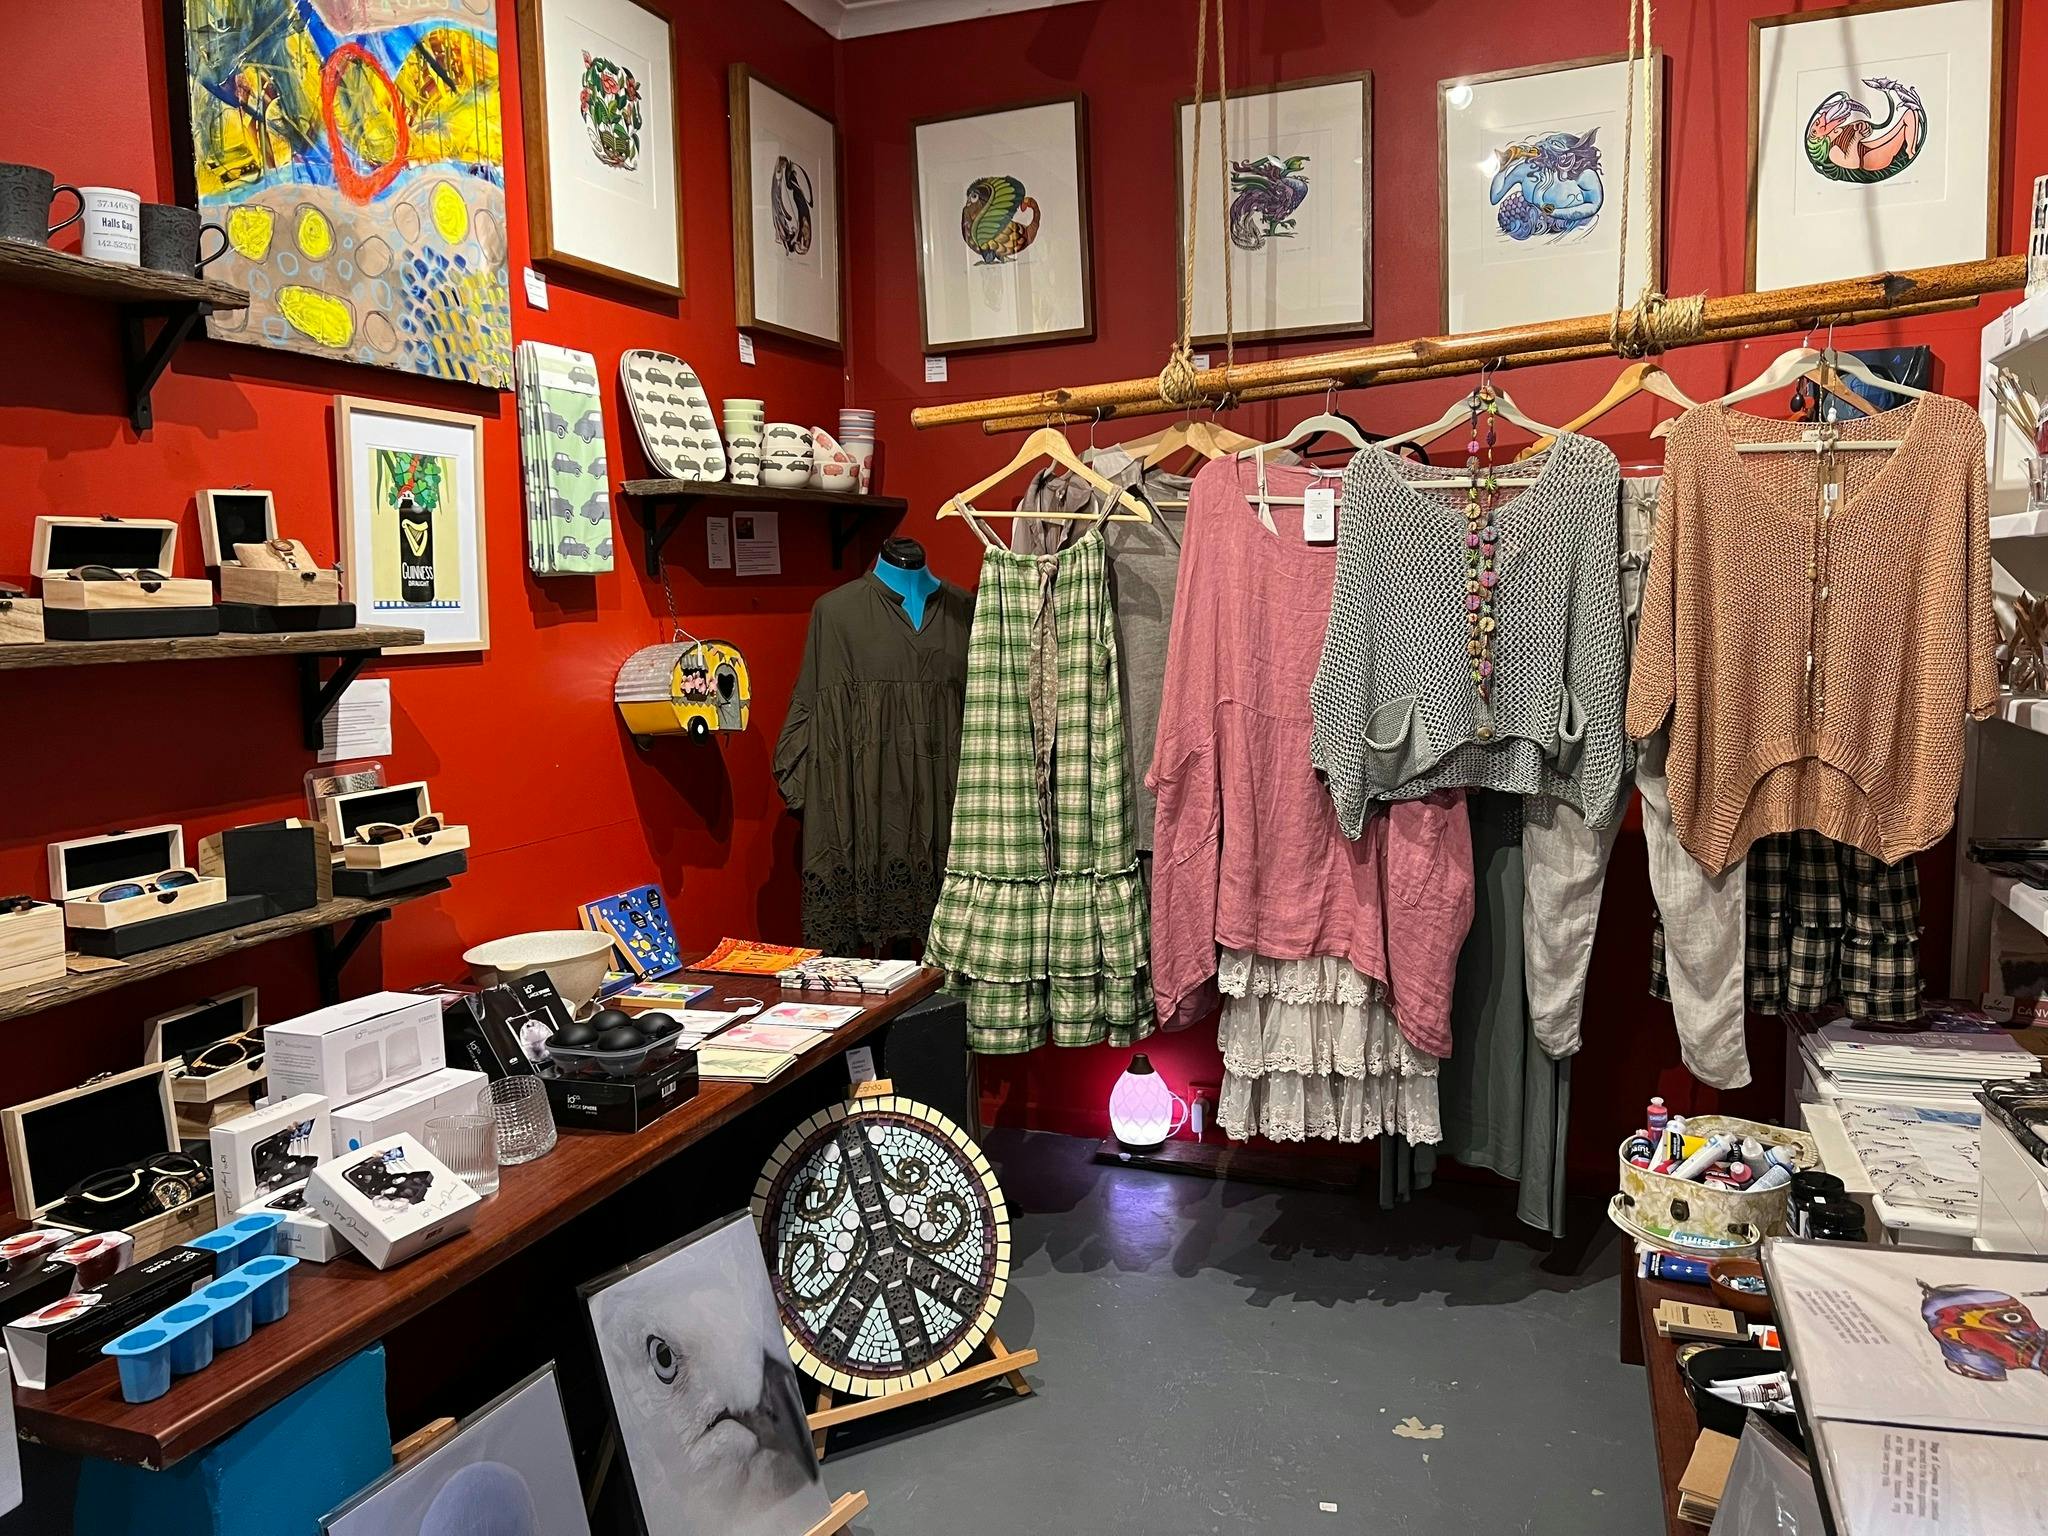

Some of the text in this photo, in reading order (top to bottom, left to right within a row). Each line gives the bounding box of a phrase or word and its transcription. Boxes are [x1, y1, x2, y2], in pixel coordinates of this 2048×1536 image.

[102, 217, 133, 233] Halls Gap
[402, 562, 434, 580] GUINNESS
